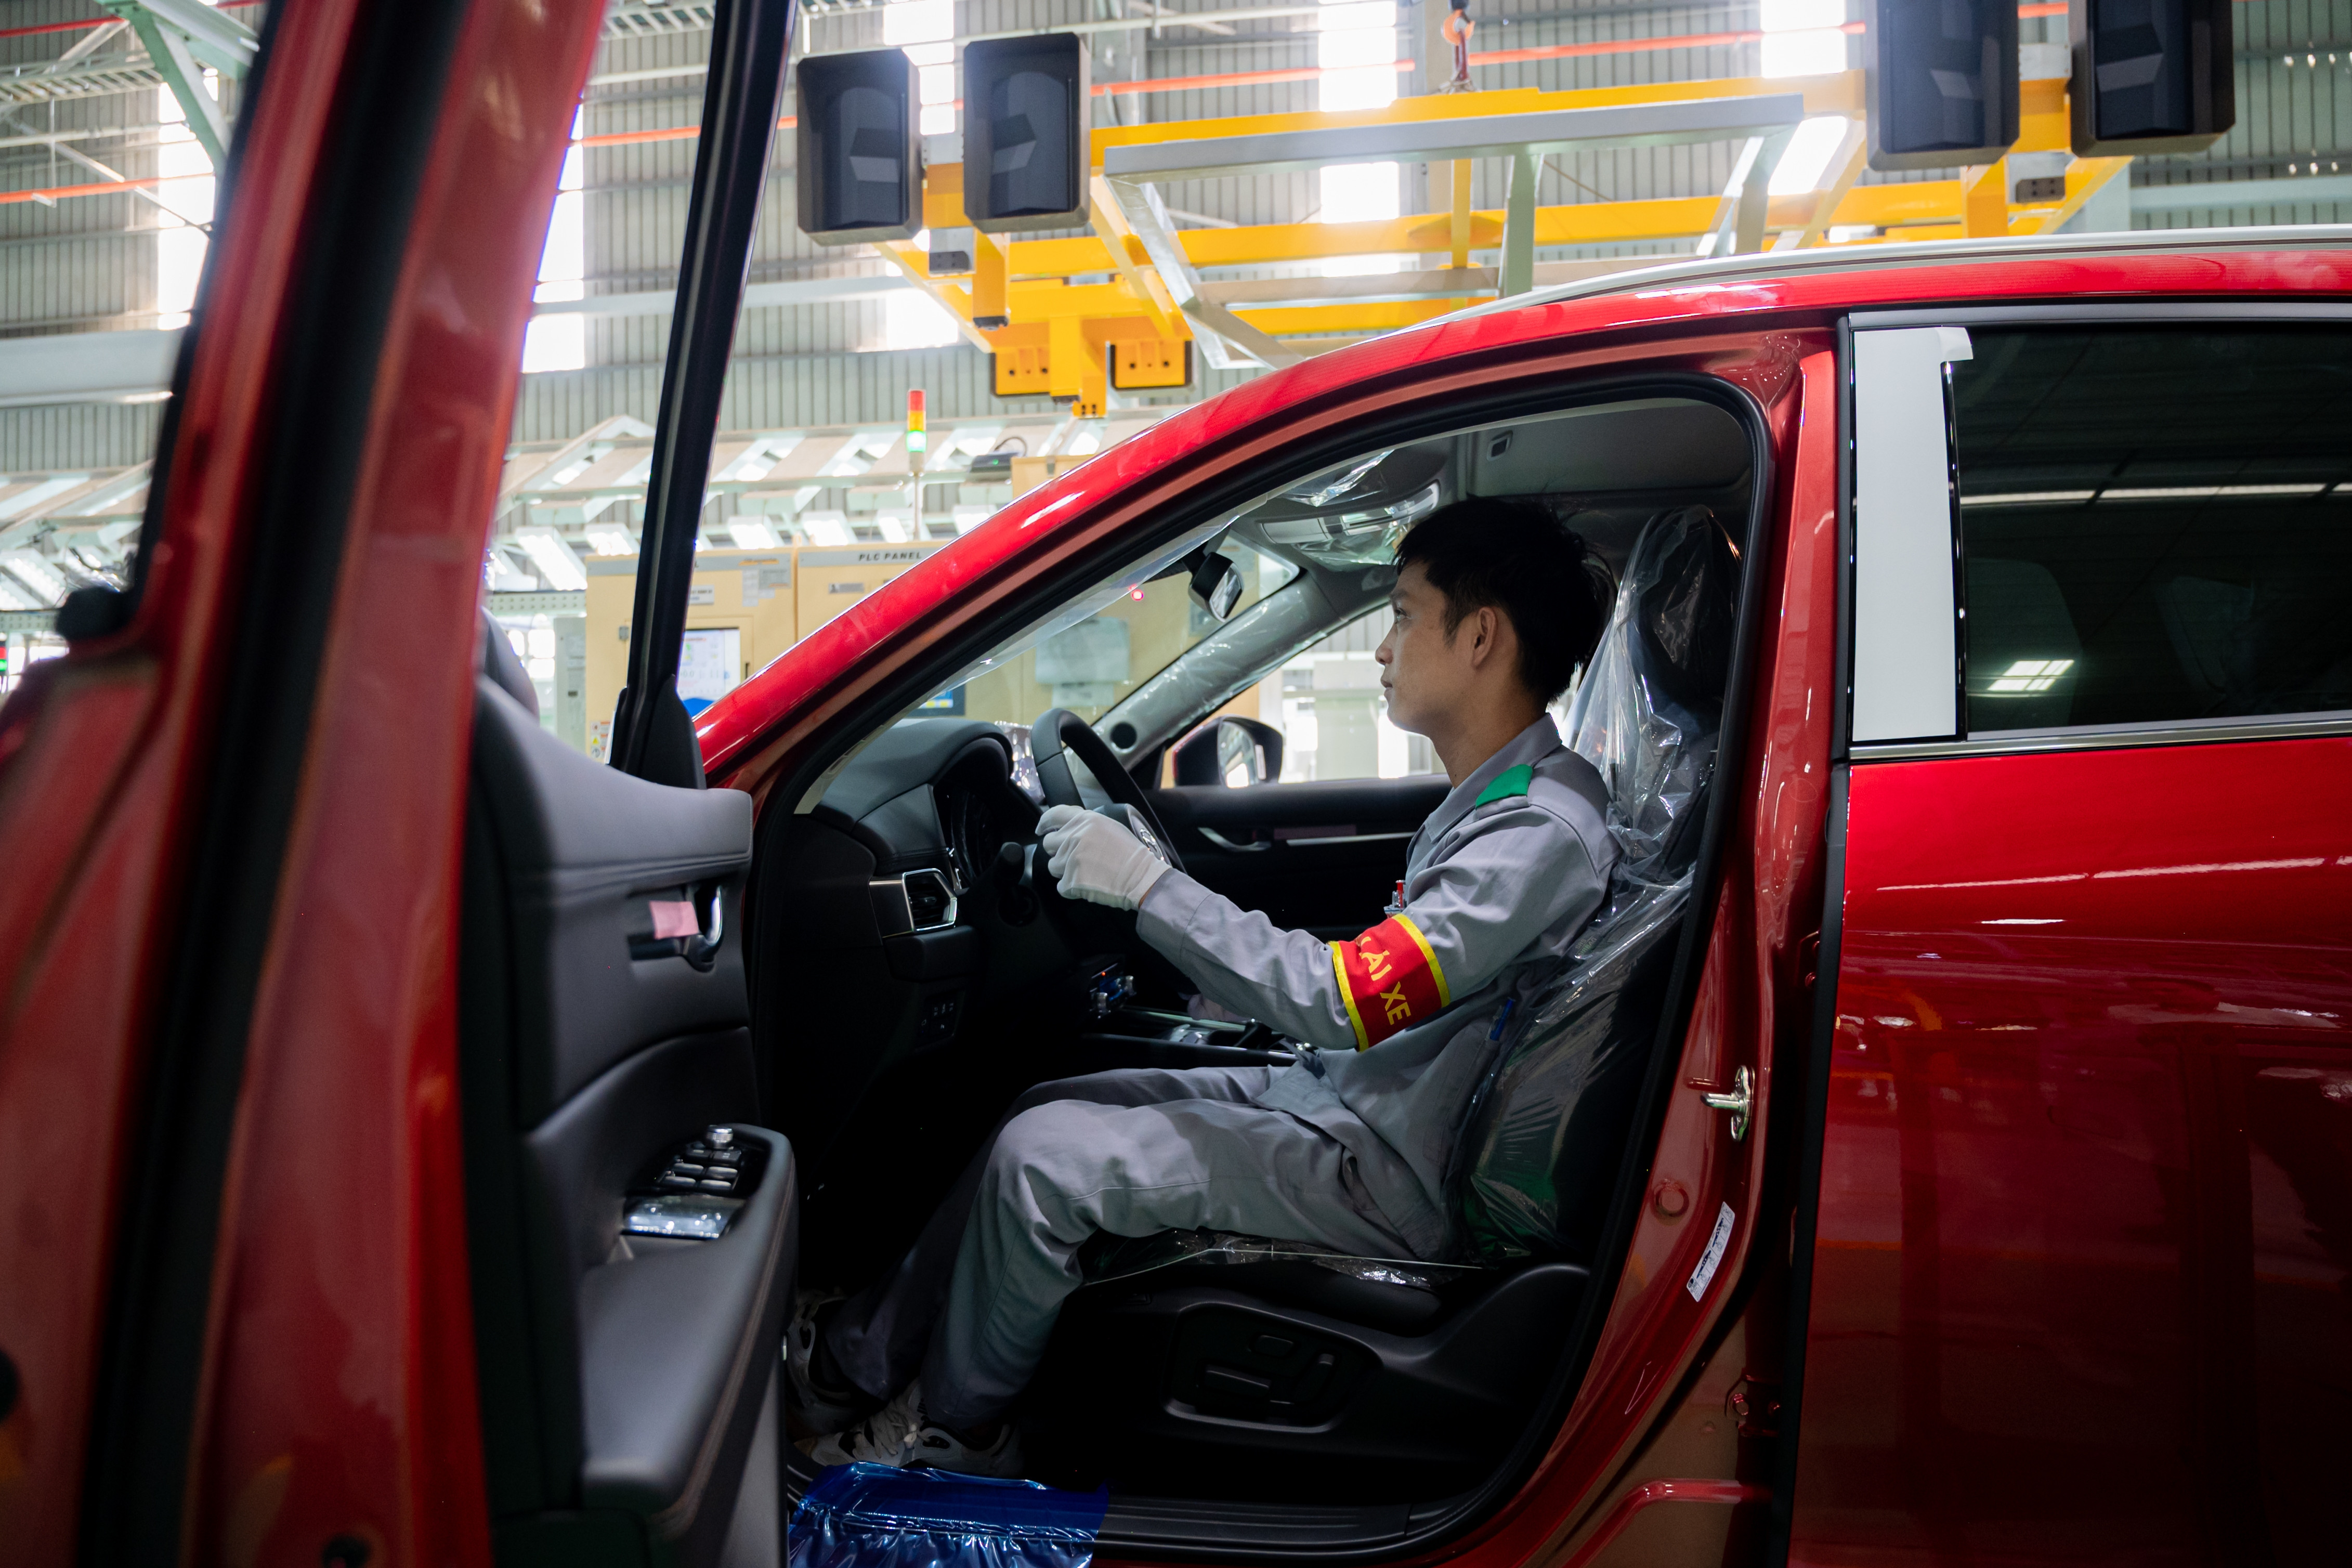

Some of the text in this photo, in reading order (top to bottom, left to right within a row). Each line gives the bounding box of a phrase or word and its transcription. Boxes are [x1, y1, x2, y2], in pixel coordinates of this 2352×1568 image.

[859, 552, 922, 561] PLC PANEL
[1379, 981, 1412, 1026] XE
